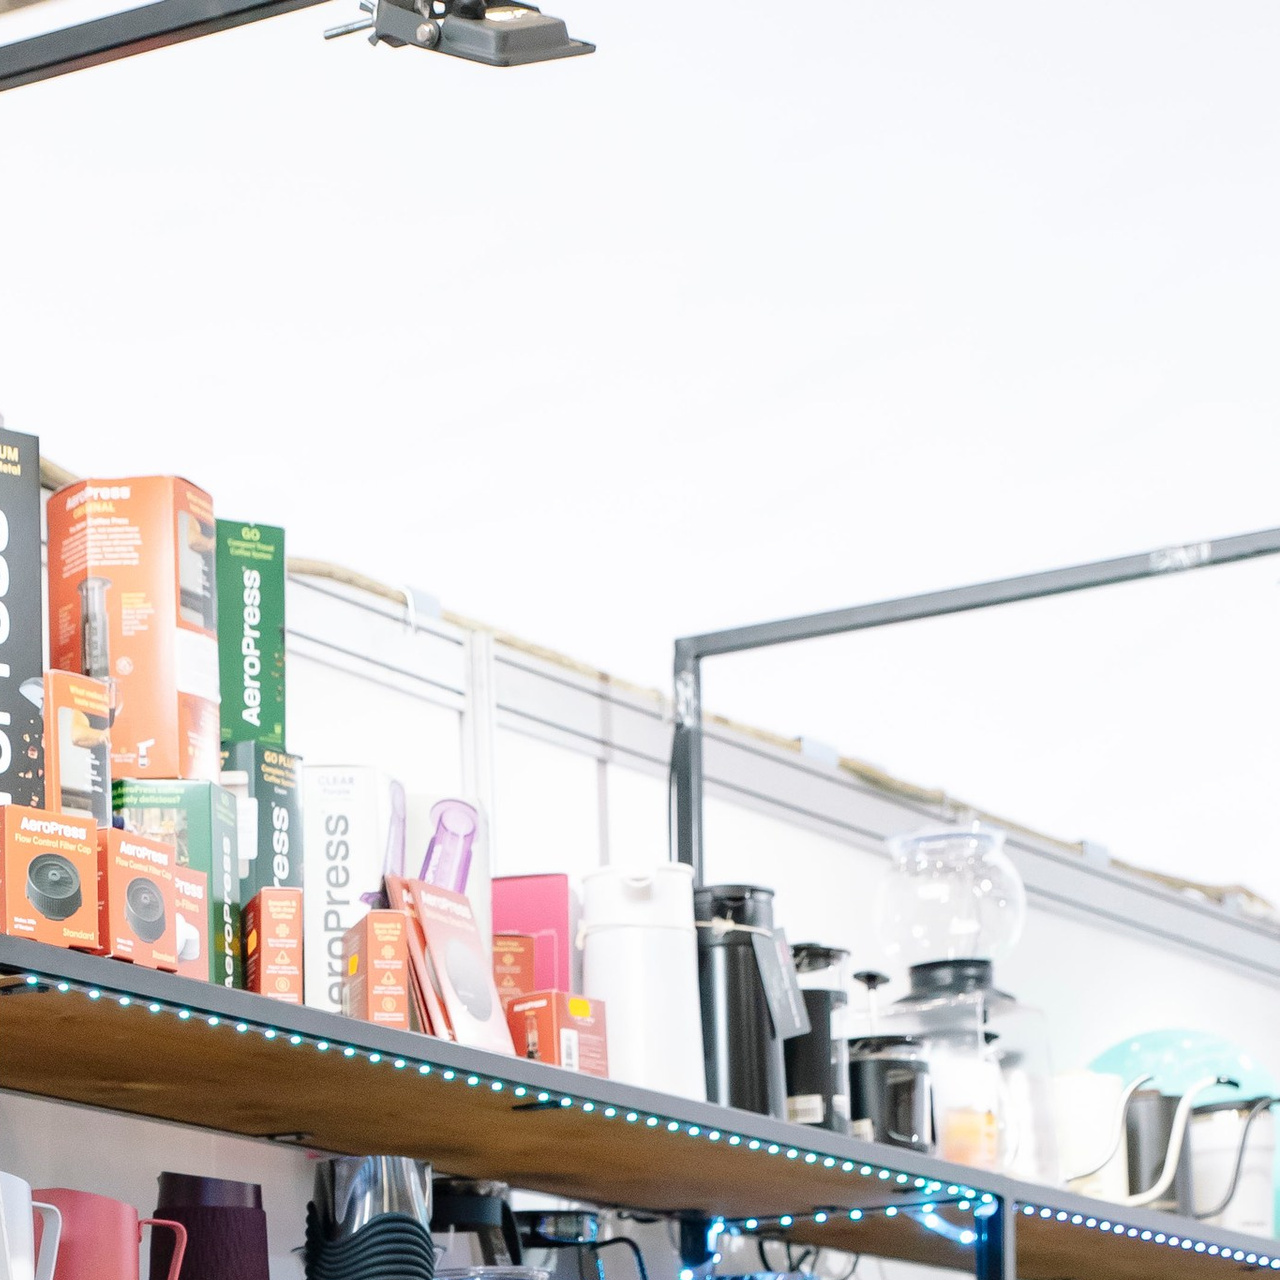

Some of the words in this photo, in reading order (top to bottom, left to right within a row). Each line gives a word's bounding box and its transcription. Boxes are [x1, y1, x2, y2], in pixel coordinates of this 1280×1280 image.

[242, 569, 260, 727] AeroPress
[21, 817, 87, 840] AeroPress
[15, 833, 32, 843] Flow
[33, 836, 59, 848] Control
[60, 841, 76, 851] Filter
[77, 844, 91, 855] Cap
[63, 928, 94, 940] Standard
